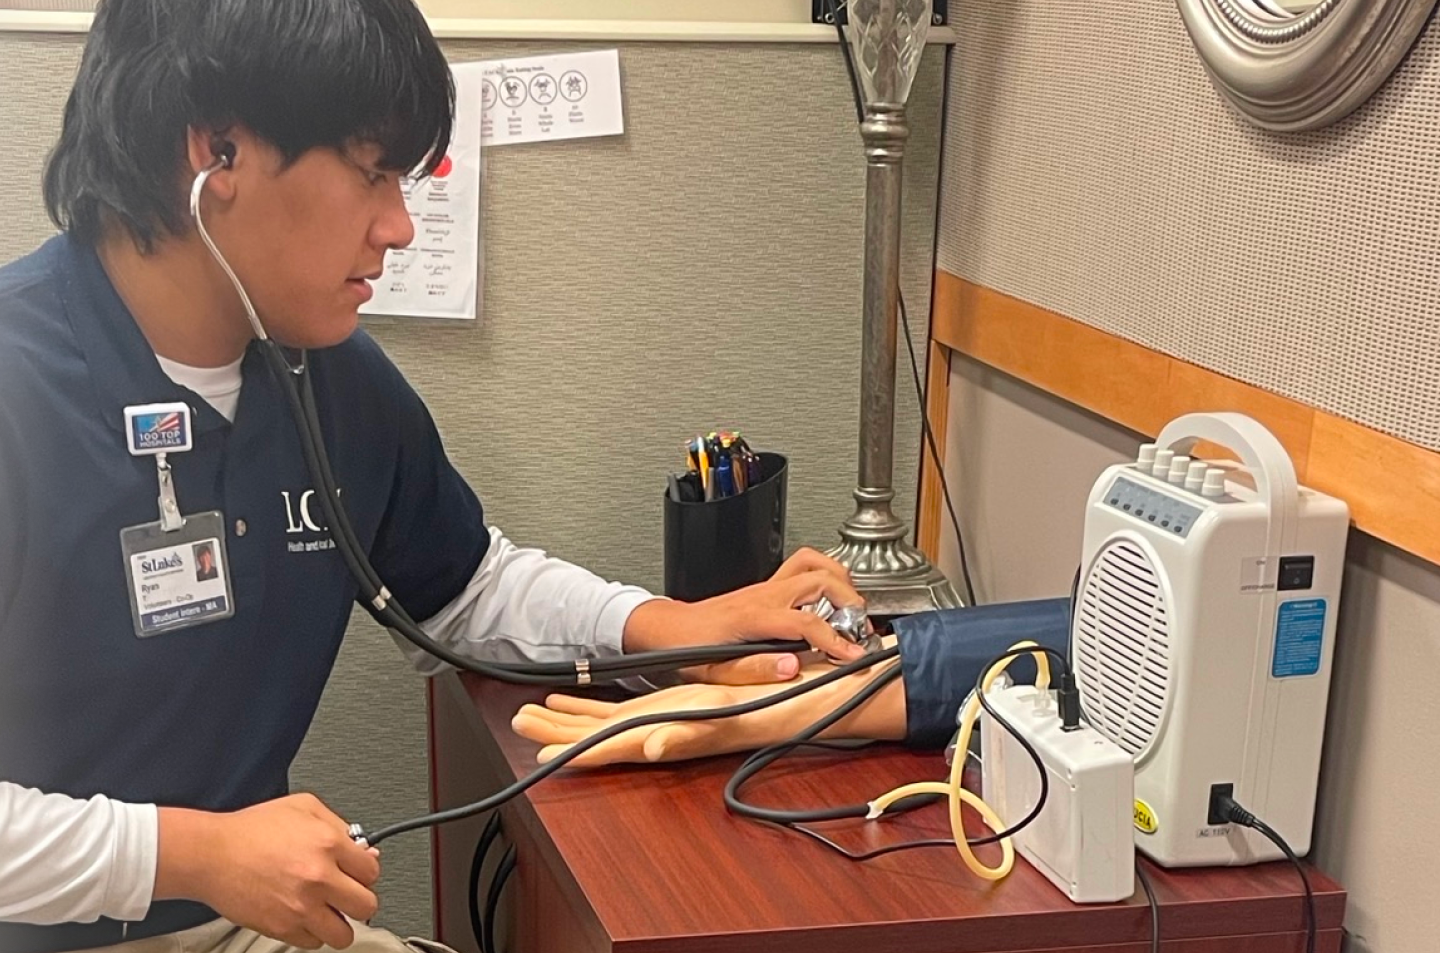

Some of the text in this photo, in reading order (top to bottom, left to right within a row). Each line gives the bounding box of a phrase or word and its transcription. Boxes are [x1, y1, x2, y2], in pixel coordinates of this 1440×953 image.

[139, 430, 180, 442] 100 TOP
[151, 610, 180, 624] Student
